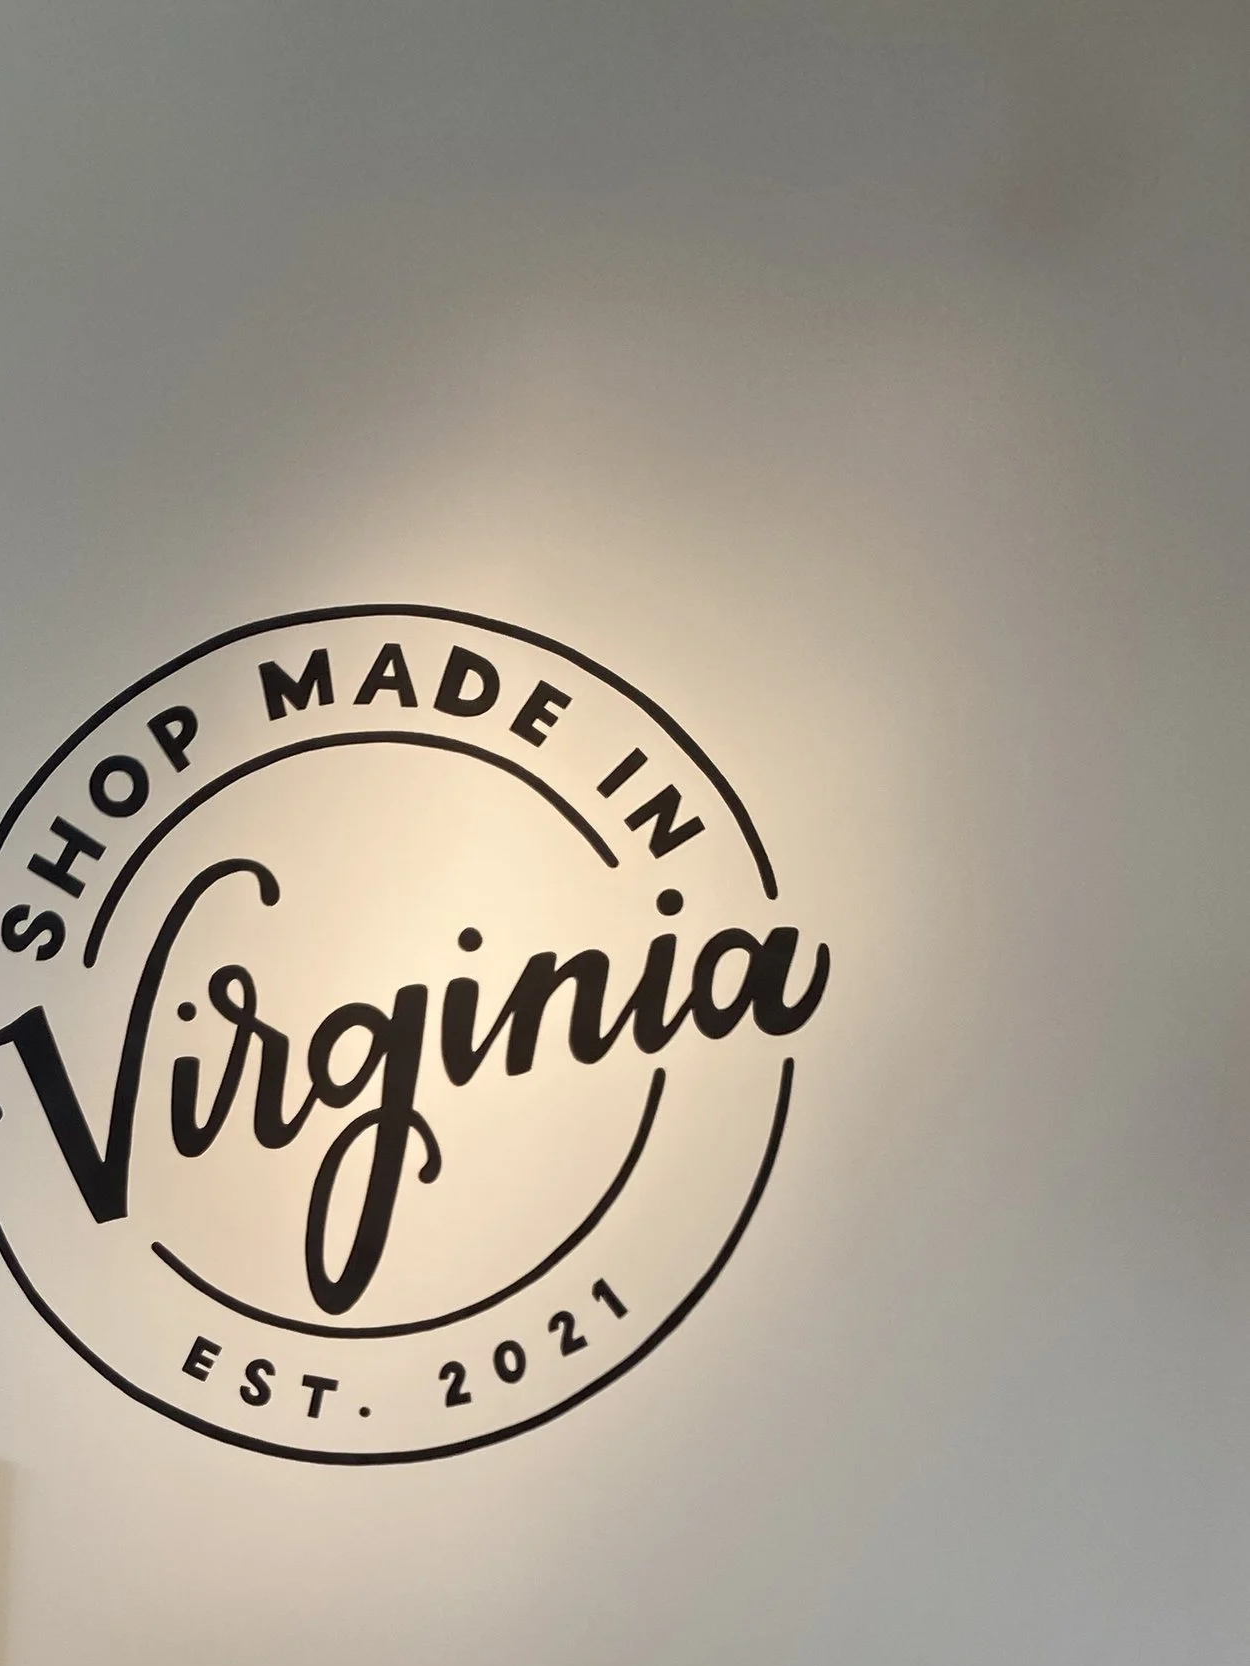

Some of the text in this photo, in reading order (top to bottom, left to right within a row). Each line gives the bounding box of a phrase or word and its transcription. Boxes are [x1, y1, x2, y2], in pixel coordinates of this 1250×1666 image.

[1, 643, 705, 961] SHOP MADE IN
[181, 1278, 629, 1420] EST. 2021
